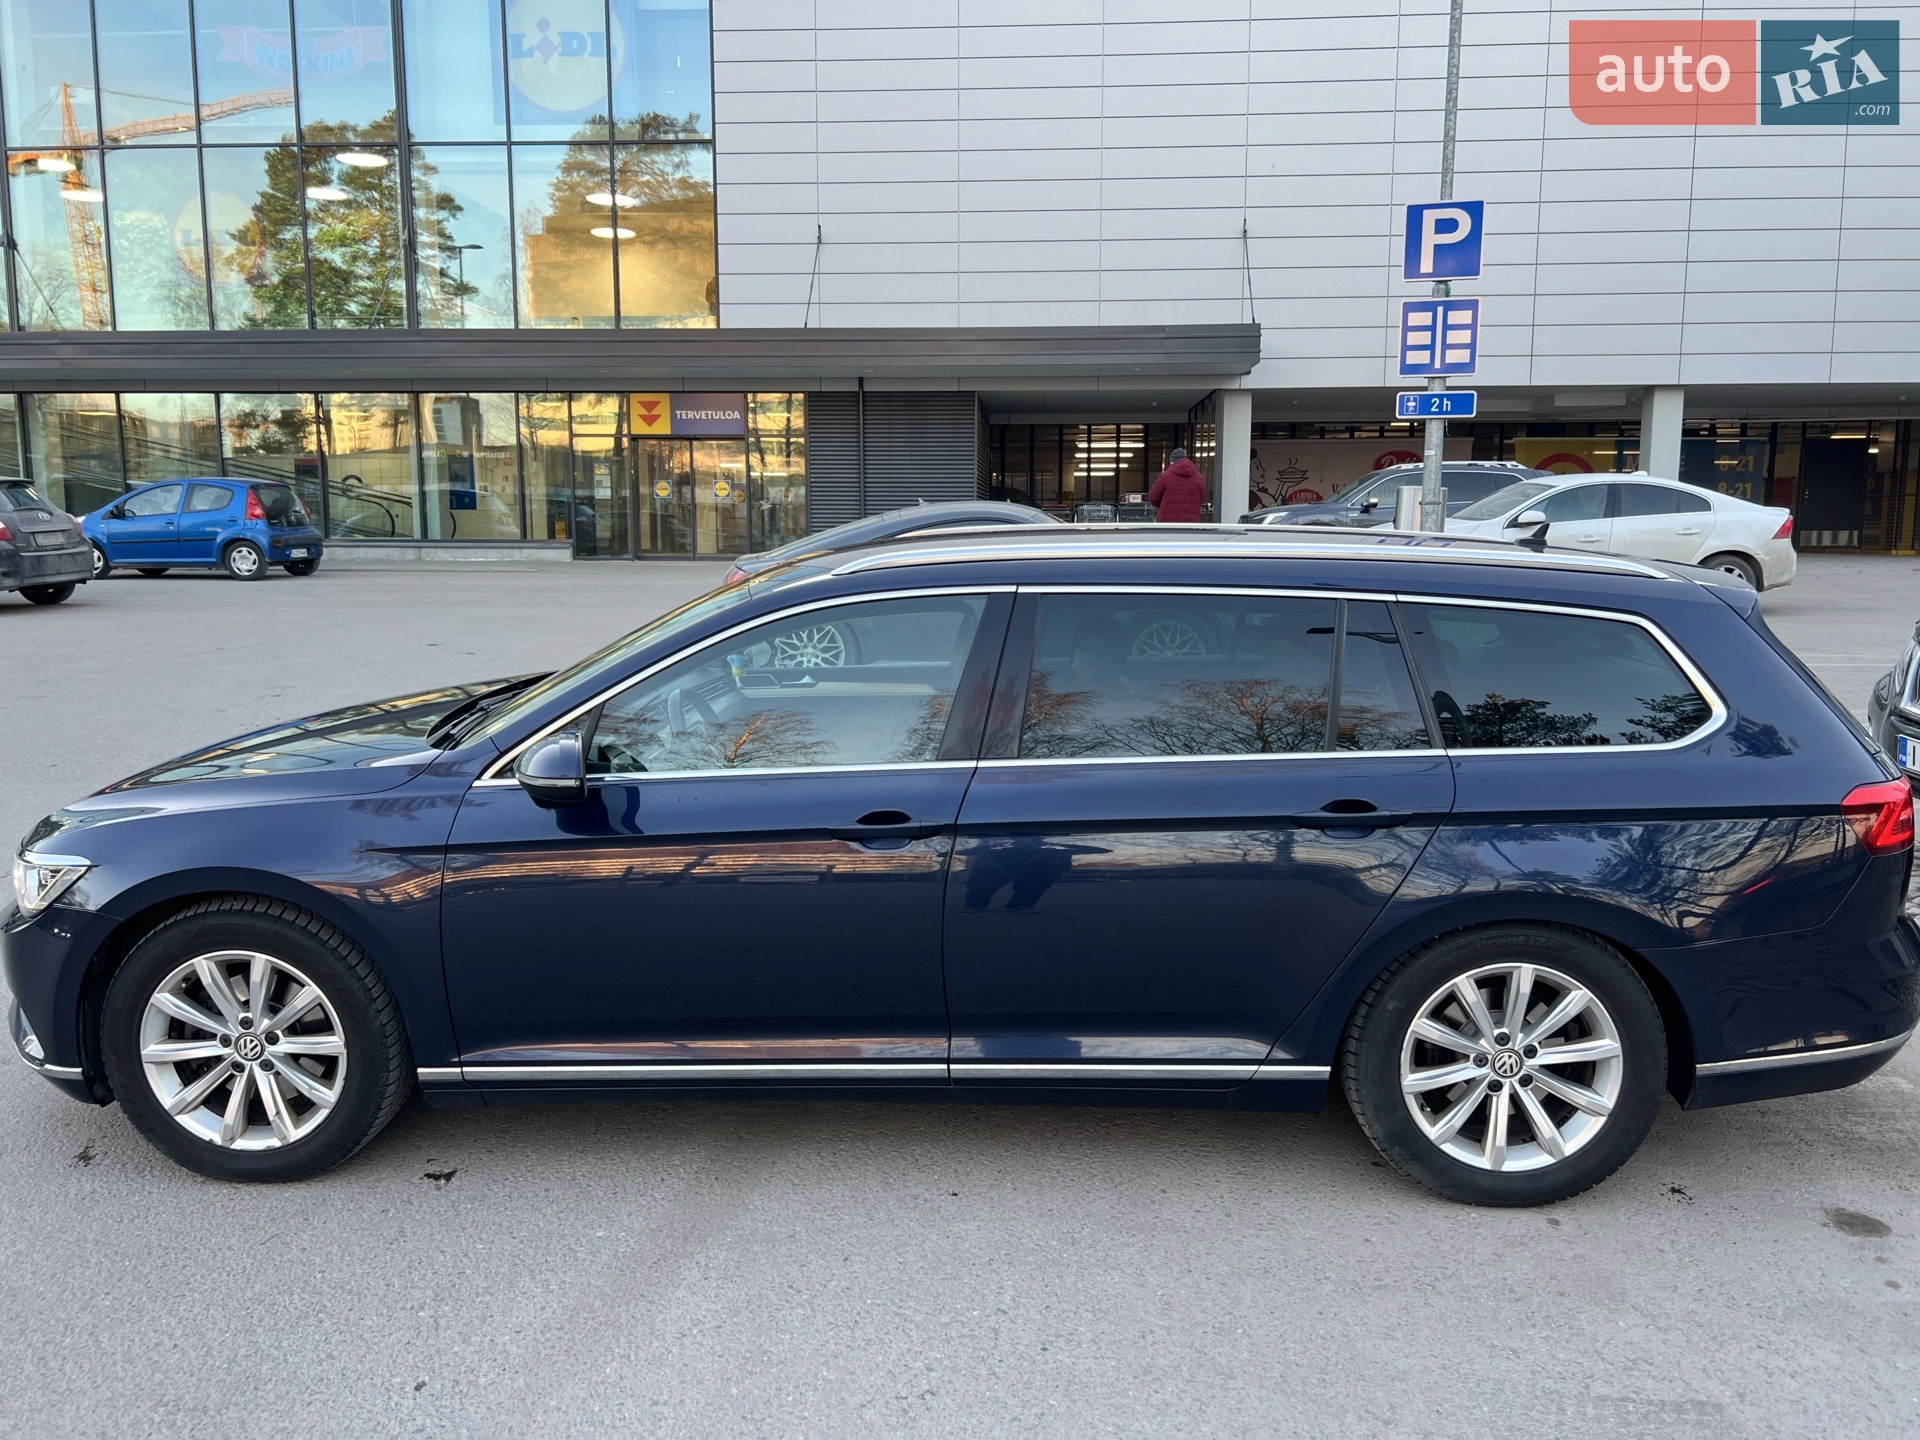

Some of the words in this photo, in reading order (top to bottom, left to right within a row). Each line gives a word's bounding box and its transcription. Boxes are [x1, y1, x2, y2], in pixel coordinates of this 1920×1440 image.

[1419, 208, 1472, 274] P
[1430, 397, 1440, 412] 2
[1443, 397, 1452, 412] h
[675, 410, 741, 420] TERVETULOA
[1719, 455, 1755, 472] 8-21
